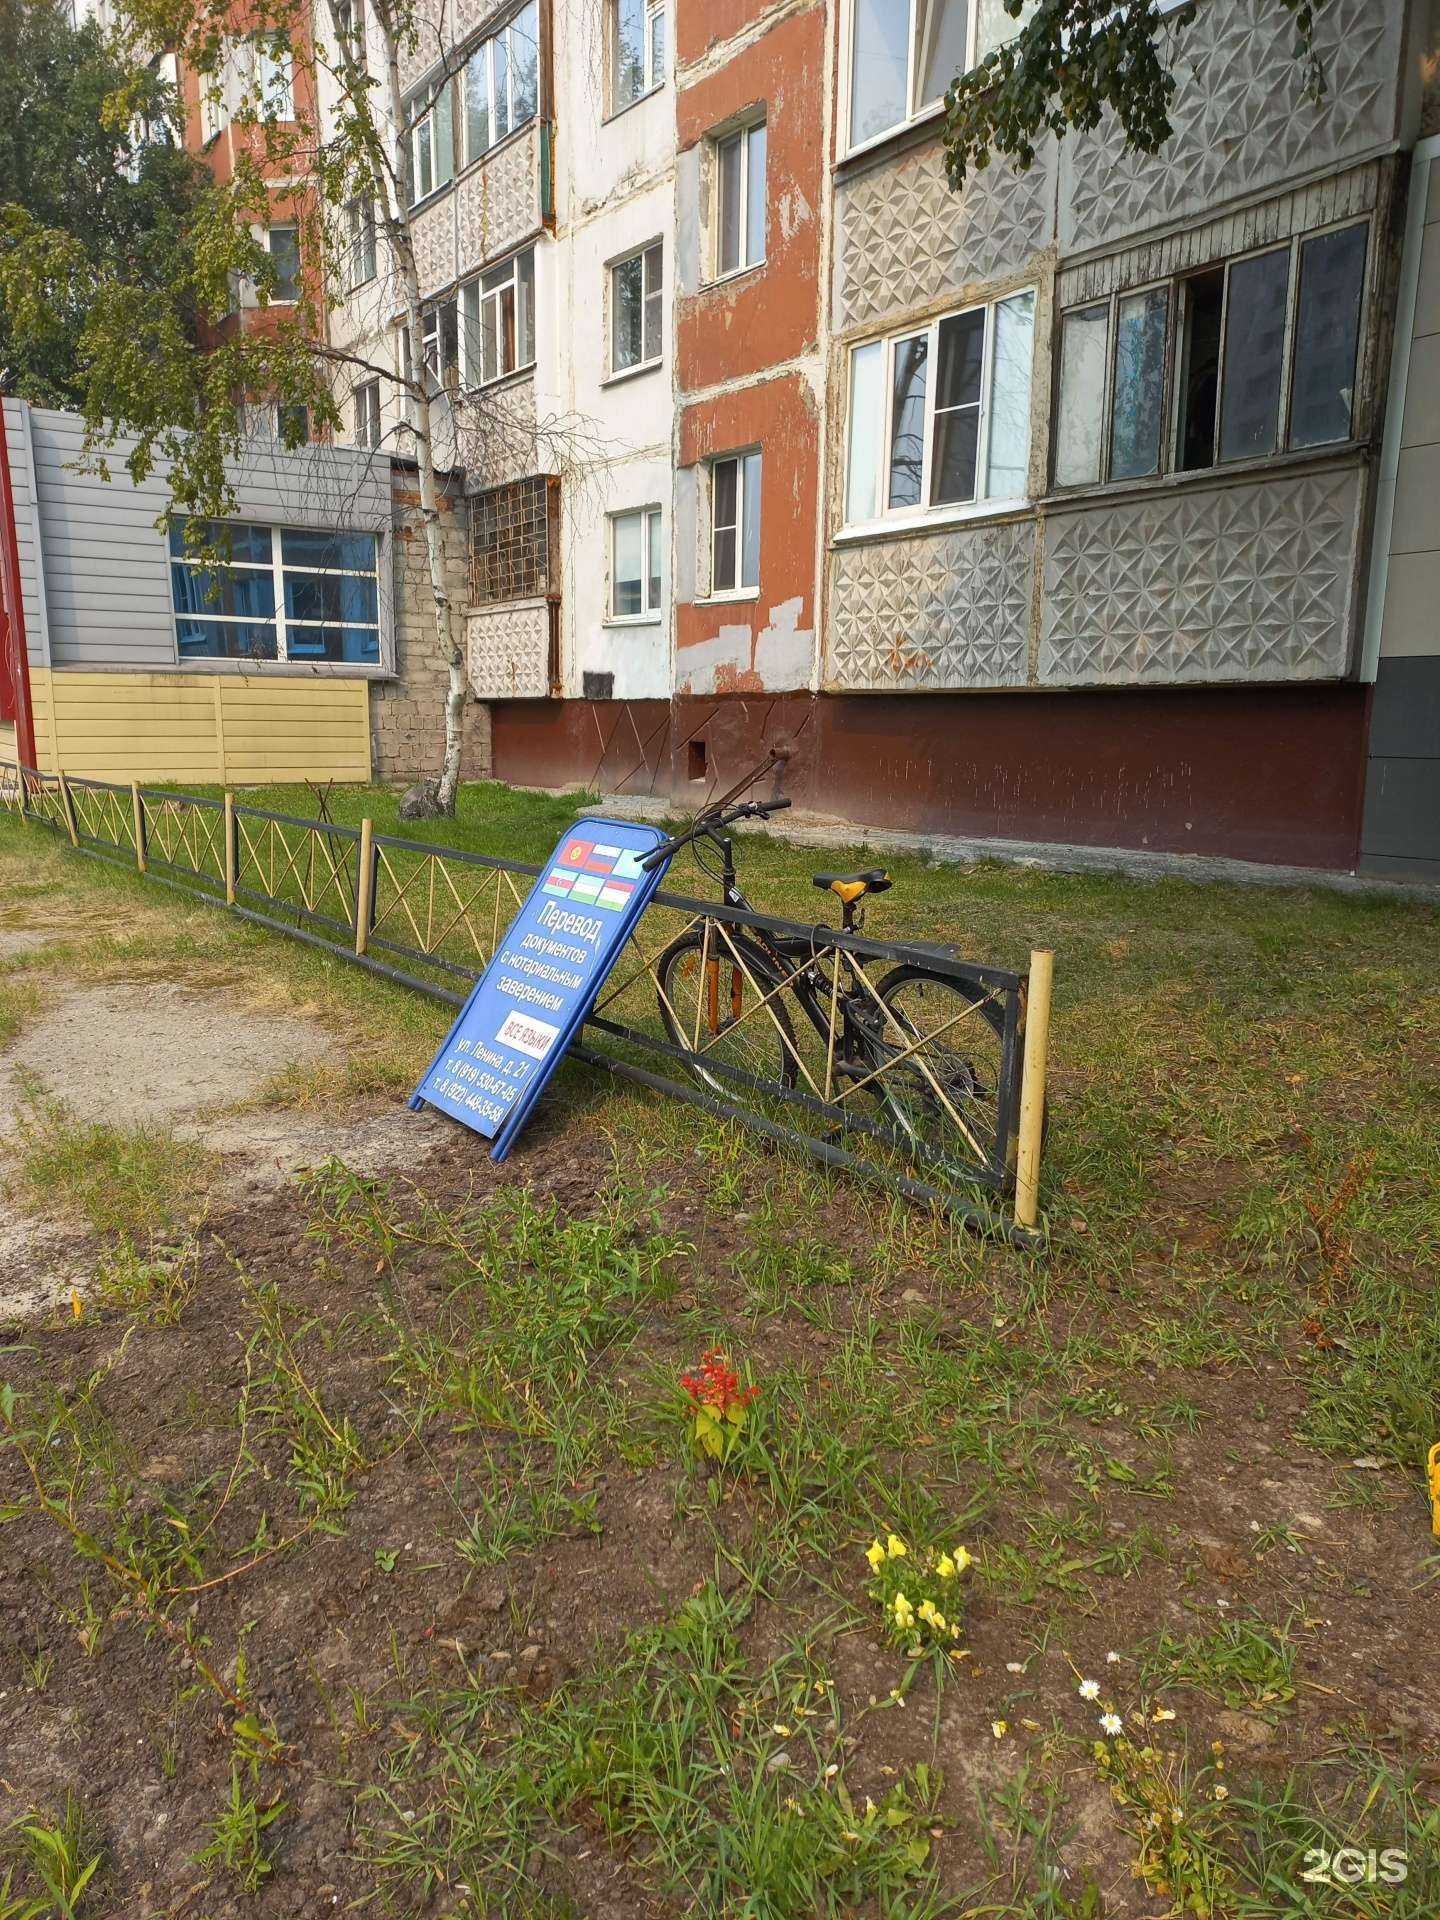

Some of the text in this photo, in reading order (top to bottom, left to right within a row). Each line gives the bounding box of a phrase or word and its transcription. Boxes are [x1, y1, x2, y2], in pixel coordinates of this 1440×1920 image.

[537, 899, 603, 944] Перевод
[519, 933, 588, 964] документов
[500, 950, 583, 989] с нотариальным
[496, 975, 564, 1011] заверением
[504, 1021, 551, 1051] ВСЕ ЯЗЫКИ
[451, 1060, 461, 1074] 8
[455, 1038, 469, 1053] ул.
[470, 1041, 504, 1072] Ленина,
[513, 1061, 530, 1079] 21
[455, 1061, 480, 1086] (919)
[439, 1079, 449, 1092] 8
